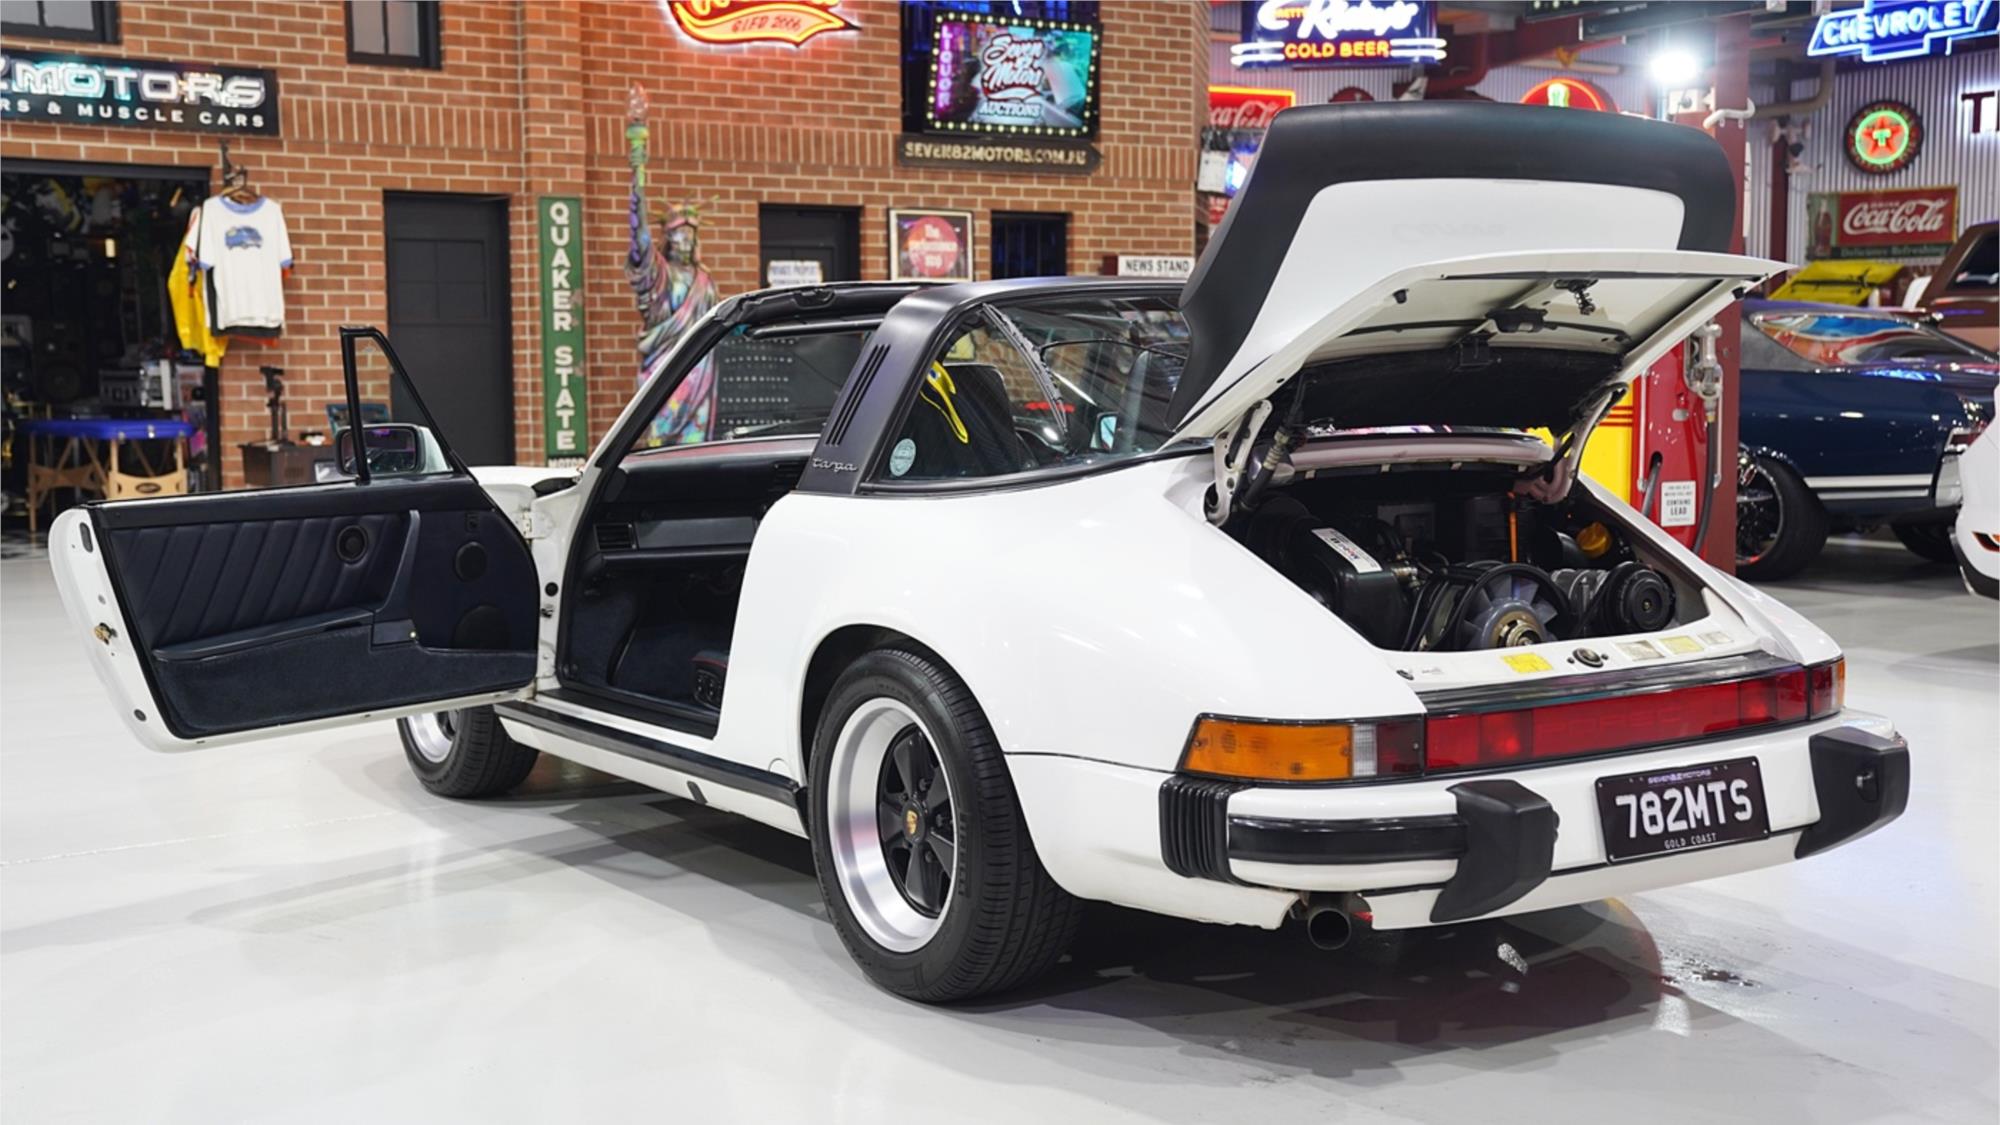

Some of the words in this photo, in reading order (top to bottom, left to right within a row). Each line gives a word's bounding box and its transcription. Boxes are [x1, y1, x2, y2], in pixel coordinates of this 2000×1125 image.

[1822, 0, 1980, 46] CHEVROLET
[938, 25, 953, 108] LIQUOR
[1285, 42, 1335, 59] COLD
[1340, 40, 1390, 58] BEER
[0, 55, 265, 108] MOTORS
[47, 102, 61, 115] &
[78, 103, 184, 124] MUSCLE
[199, 112, 265, 128] CARS
[1961, 90, 2000, 133] T
[1843, 199, 1949, 236] Coca-Cola
[549, 201, 572, 332] QUAKER
[1125, 259, 1154, 272] NEWS
[1156, 259, 1190, 272] STAND
[554, 345, 576, 450] STATE
[812, 458, 859, 473] targa
[1670, 506, 1687, 516] LEAD
[1615, 779, 1753, 839] 782MTS
[1664, 838, 1687, 850] GOLD
[1691, 833, 1717, 845] COAST
